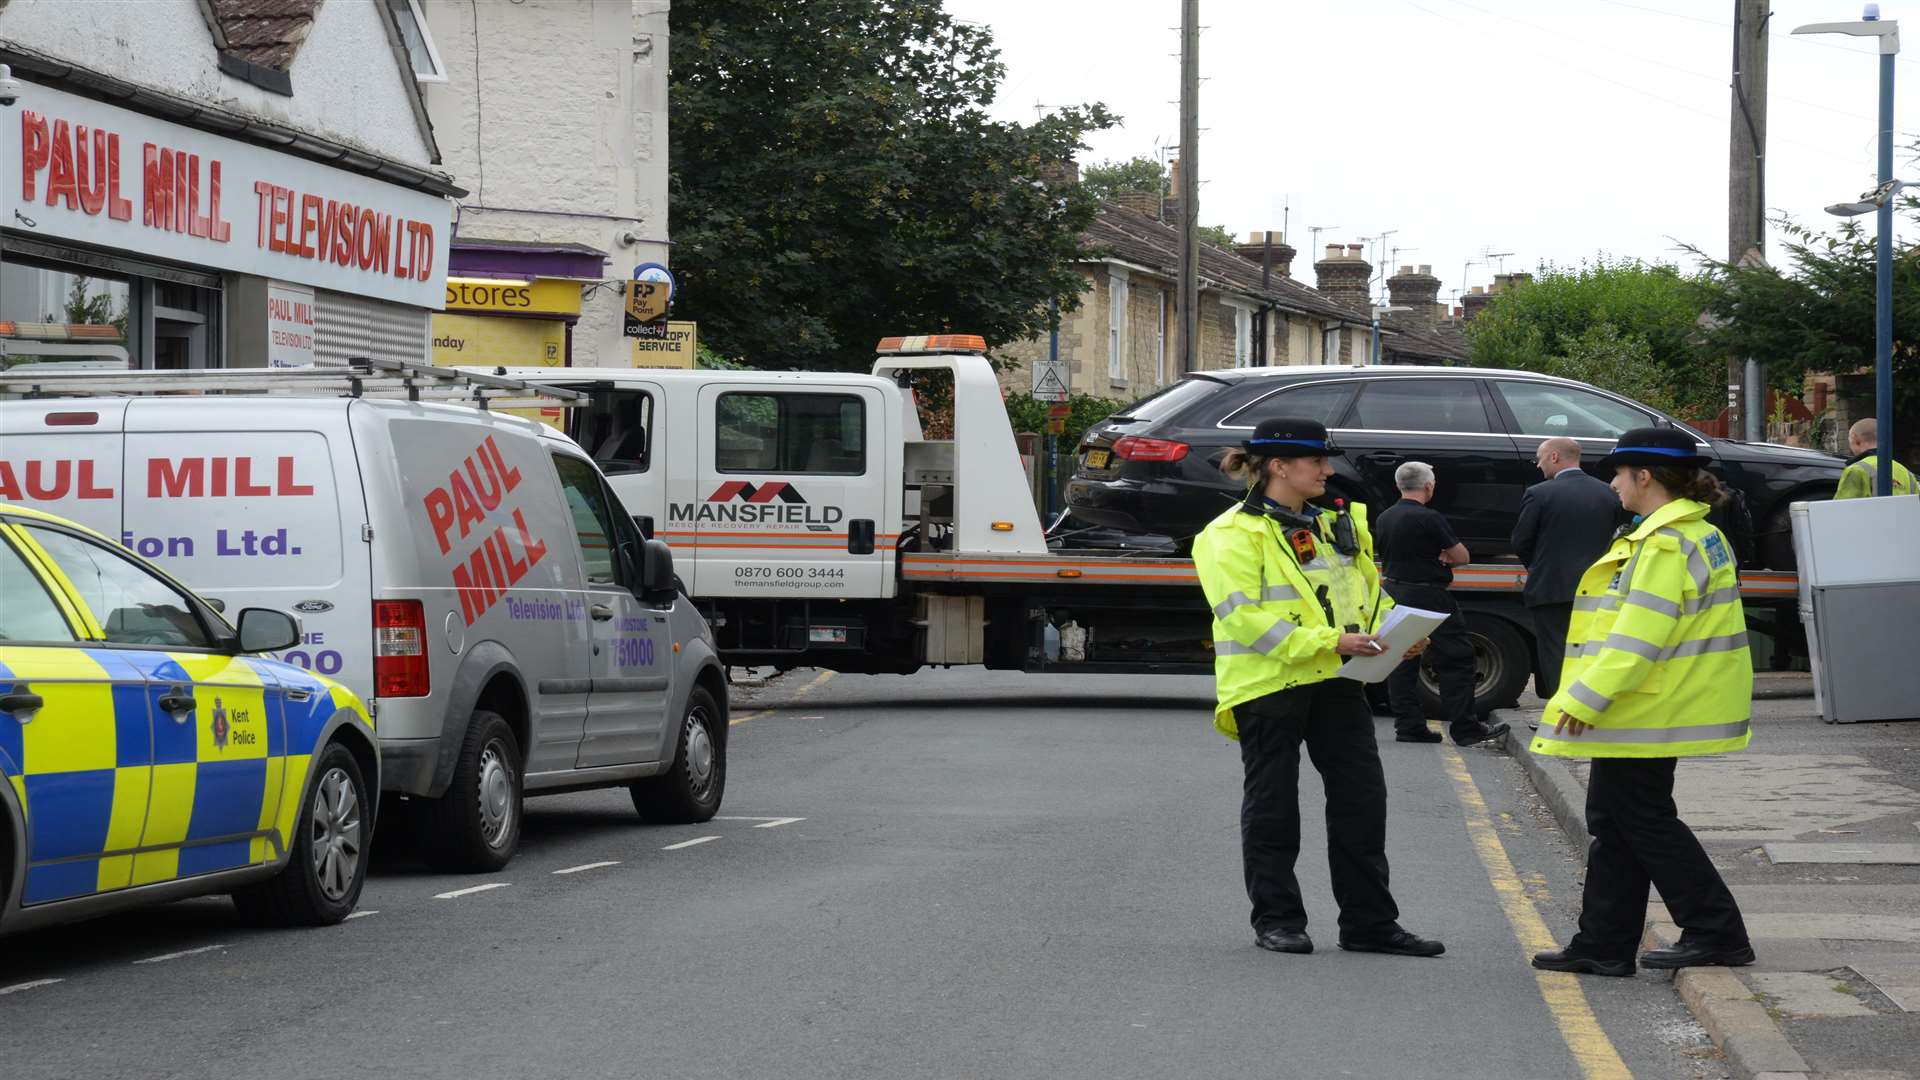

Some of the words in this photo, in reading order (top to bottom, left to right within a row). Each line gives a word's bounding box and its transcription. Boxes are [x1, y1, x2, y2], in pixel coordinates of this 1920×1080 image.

[21, 109, 132, 221] PAUL
[142, 142, 231, 242] MILL
[254, 181, 391, 274] TELEVISION
[394, 218, 434, 281] LTD
[446, 283, 531, 307] Stores
[633, 298, 648, 306] Pay
[269, 298, 292, 322] PAUL
[294, 301, 314, 326] MILL
[633, 305, 654, 314] Point
[272, 330, 302, 348] TELEVISION
[302, 335, 312, 350] LTD
[639, 341, 682, 352] SERVICE
[147, 456, 314, 498] MILL
[423, 434, 522, 556] PAUL
[669, 503, 843, 524] MANSFIELD
[216, 528, 302, 557] Ltd.
[452, 506, 548, 628] MILL
[735, 567, 772, 578] 0870
[776, 567, 804, 578] 600
[808, 567, 845, 579] 3444
[735, 580, 845, 589] themansfieldgroup.com
[506, 597, 562, 620] Television
[231, 708, 250, 723] Kent
[233, 730, 256, 745] Police
